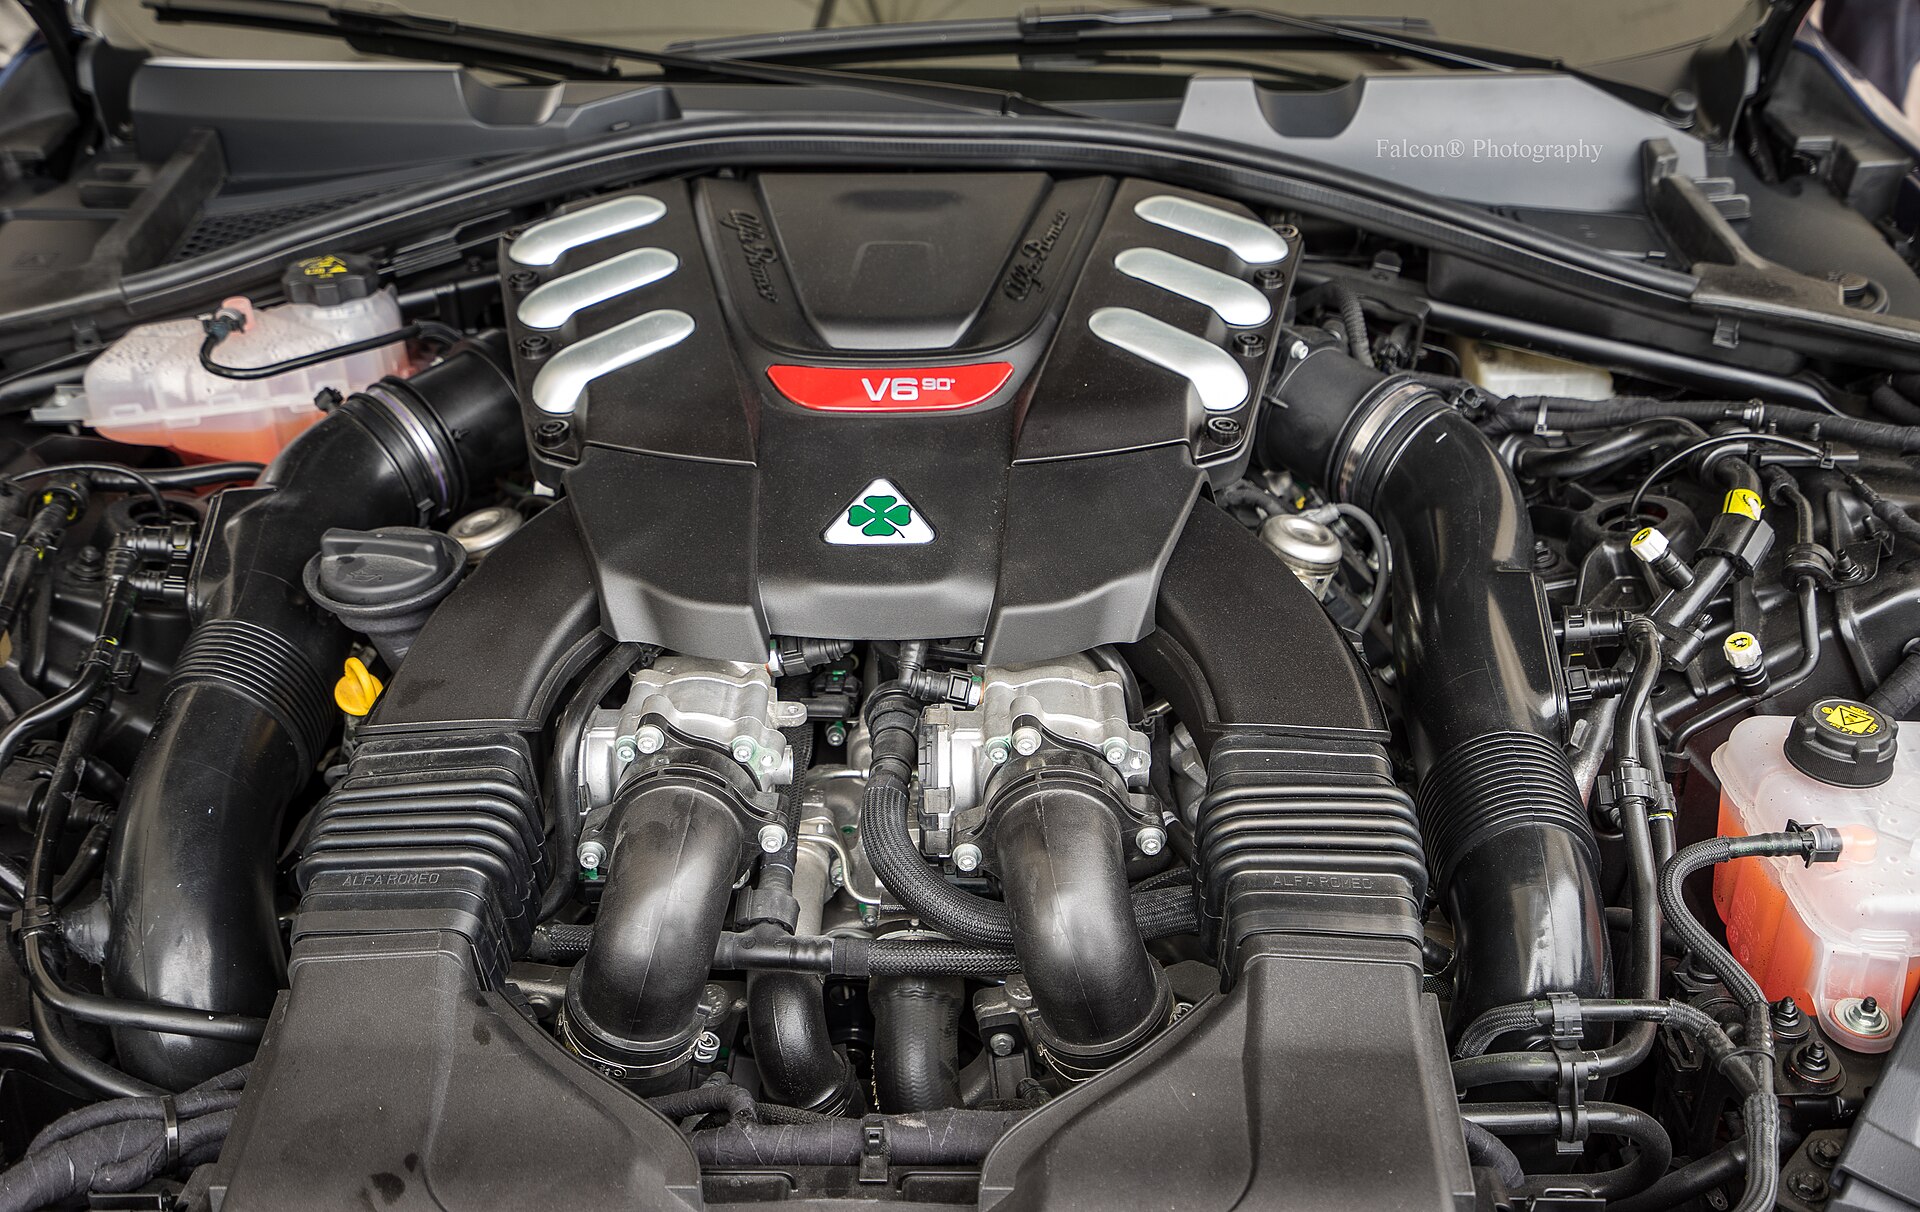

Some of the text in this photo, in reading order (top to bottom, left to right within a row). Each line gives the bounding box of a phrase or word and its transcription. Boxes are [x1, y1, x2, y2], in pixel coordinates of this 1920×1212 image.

[1003, 207, 1070, 301] Alfa Romeo
[861, 377, 919, 402] V6
[342, 873, 440, 886] ALFA ROMEO
[1273, 875, 1374, 889] ALFA ROMEO
